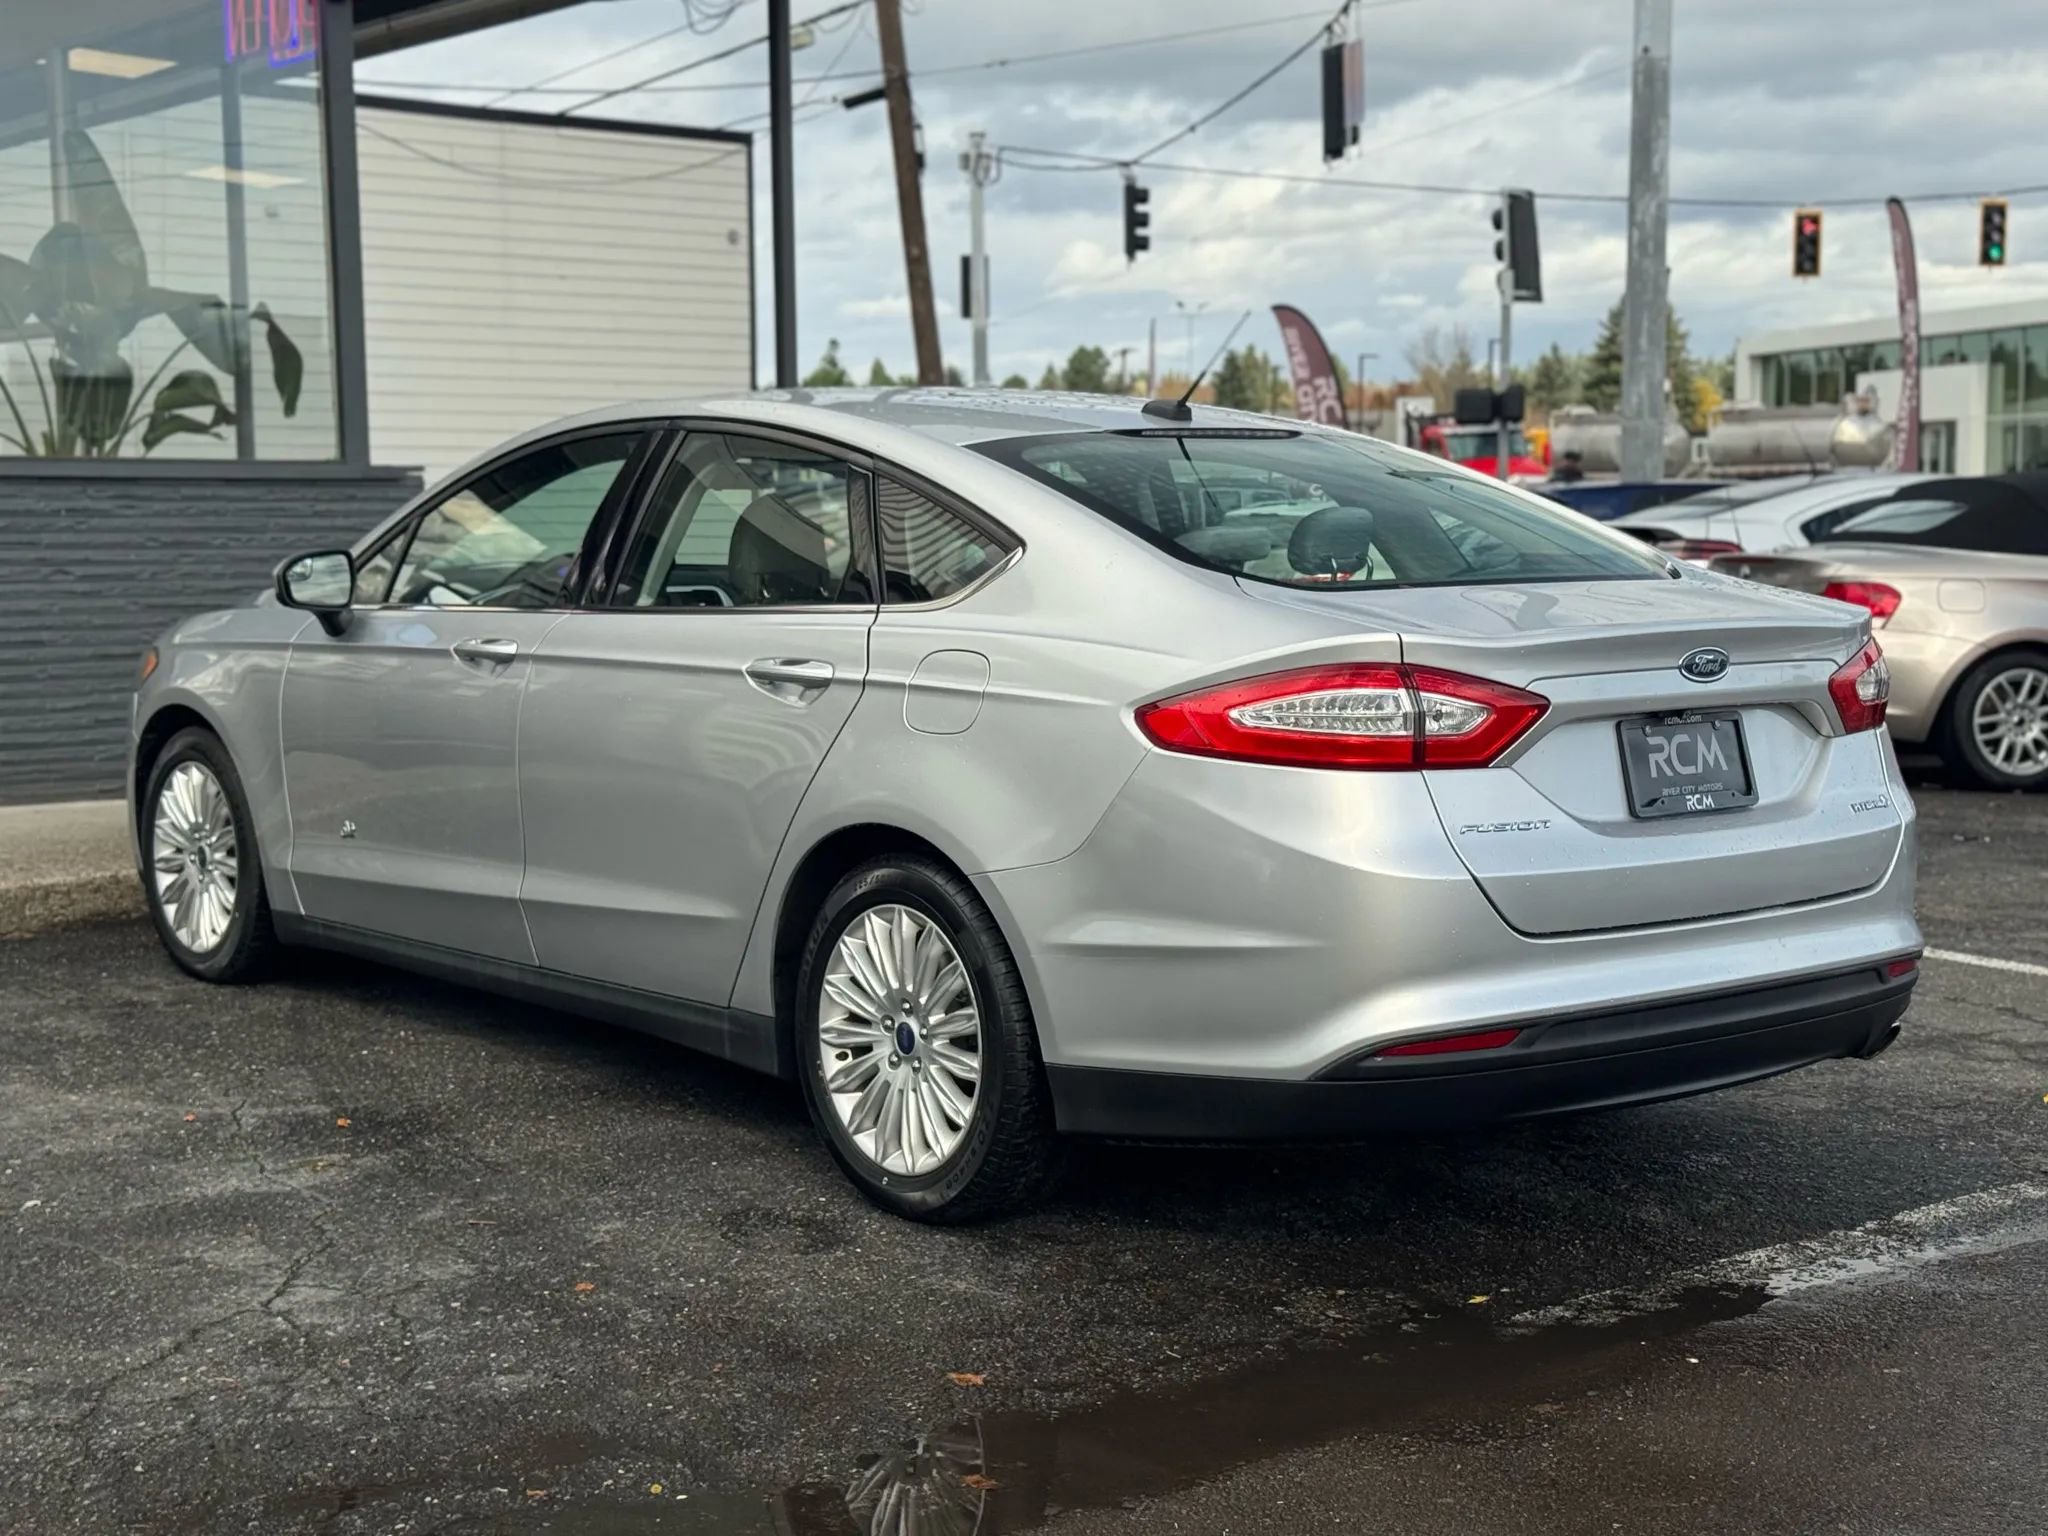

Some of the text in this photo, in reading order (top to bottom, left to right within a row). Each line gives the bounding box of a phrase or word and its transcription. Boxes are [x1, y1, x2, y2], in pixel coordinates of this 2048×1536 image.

[1646, 732, 1728, 778] RCM
[1662, 782, 1723, 796] RIVER CITY MOTORS
[1685, 793, 1715, 811] RCM
[1460, 819, 1551, 835] FUSION
